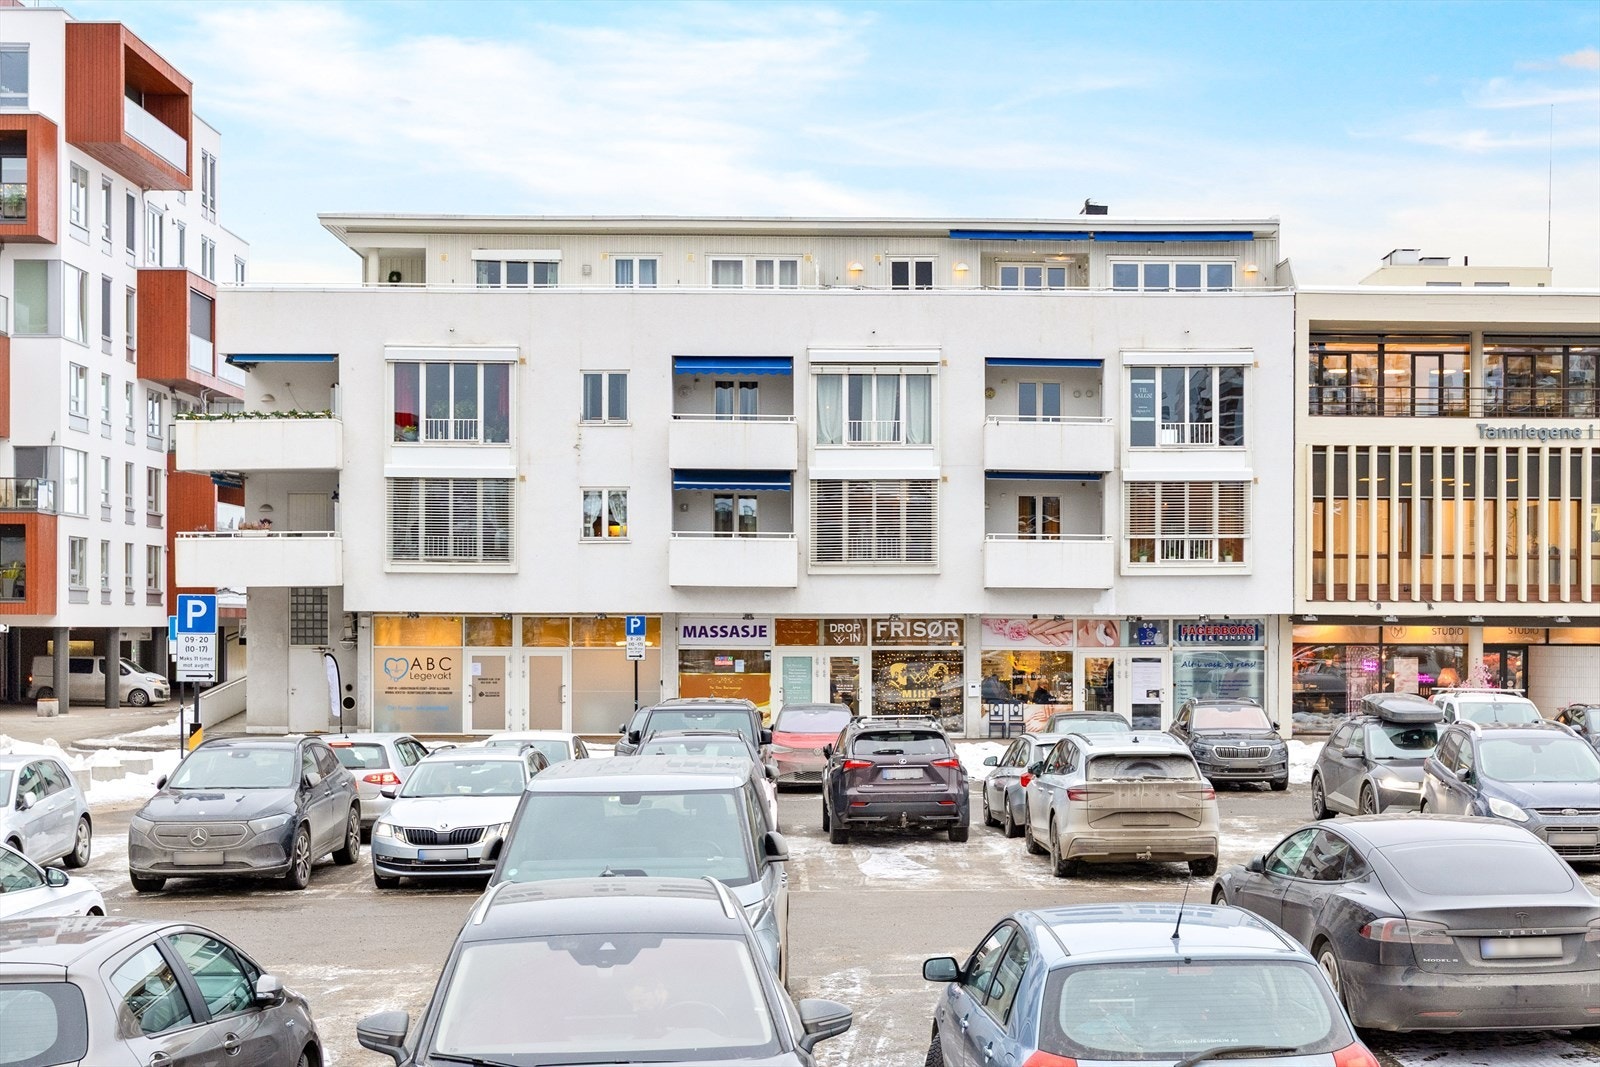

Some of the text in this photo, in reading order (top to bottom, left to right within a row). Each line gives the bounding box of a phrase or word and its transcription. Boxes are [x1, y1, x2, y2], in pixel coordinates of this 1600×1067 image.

[1476, 423, 1594, 443] Tannlegene i
[186, 599, 207, 629] P
[630, 618, 641, 634] P
[682, 625, 768, 638] MASSASJE
[829, 623, 861, 633] DROP
[875, 620, 959, 639] FRISØR
[1182, 626, 1255, 635] FAGERBORG
[1432, 627, 1464, 636] STUDIO
[410, 657, 452, 671] ABC
[410, 672, 452, 682] Legevakt
